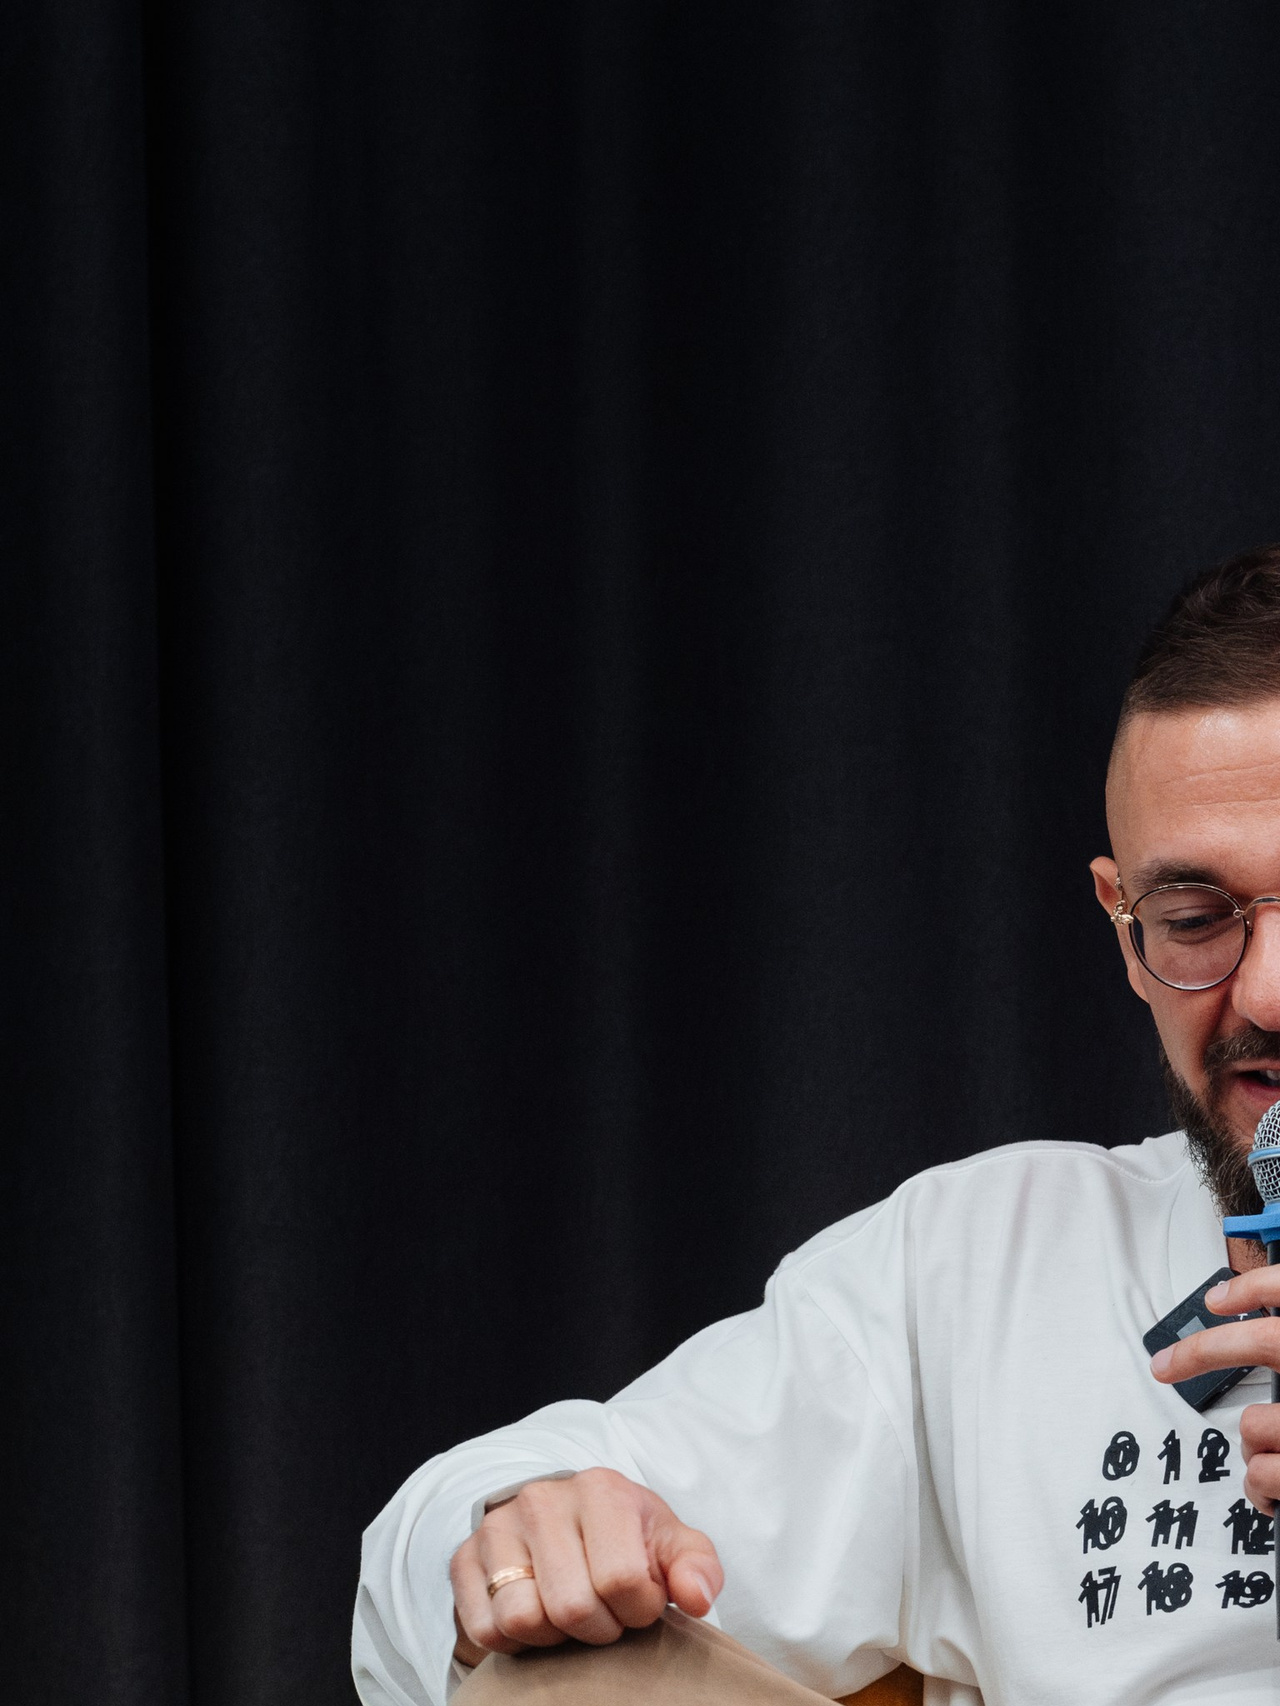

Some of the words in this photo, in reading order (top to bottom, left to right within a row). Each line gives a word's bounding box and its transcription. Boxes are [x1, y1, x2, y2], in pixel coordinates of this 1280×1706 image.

[1157, 1429, 1180, 1484] 1
[1198, 1428, 1230, 1483] 2
[1076, 1496, 1127, 1554] 10
[1145, 1499, 1199, 1549] 11
[1078, 1566, 1121, 1628] 17
[1138, 1561, 1193, 1615] 18
[1215, 1570, 1275, 1608] 19
